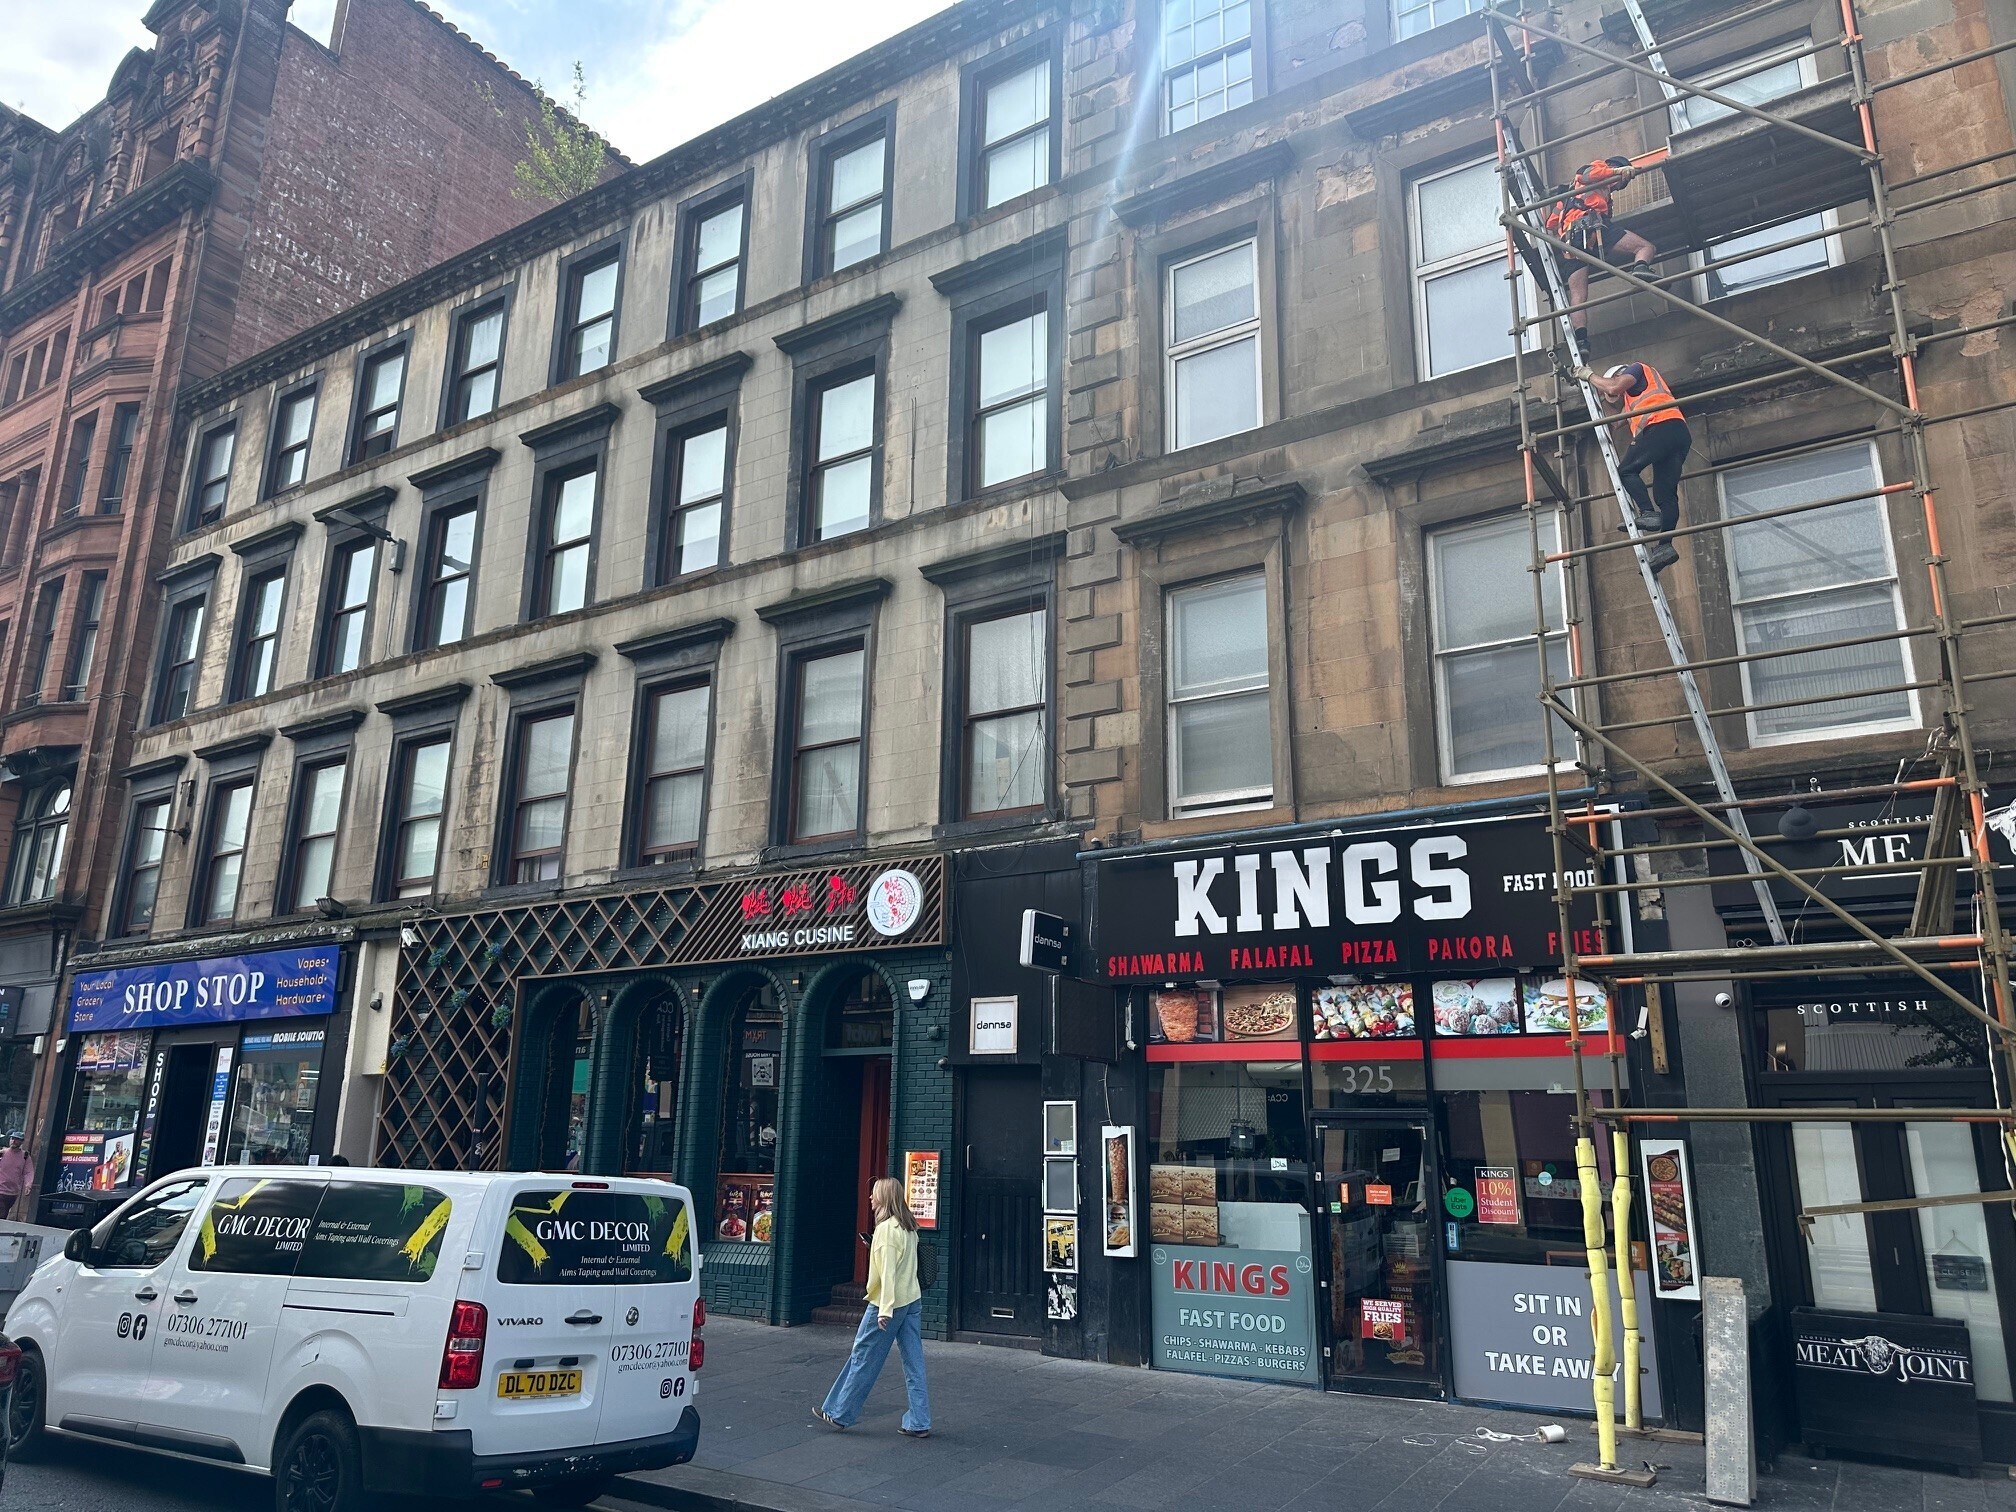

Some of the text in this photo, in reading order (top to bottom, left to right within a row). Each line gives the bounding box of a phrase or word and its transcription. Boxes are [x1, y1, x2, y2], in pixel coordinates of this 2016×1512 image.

[1848, 814, 1934, 829] SCOTTISH
[1172, 834, 1472, 937] KINGS
[1502, 872, 1547, 892] FAST
[741, 925, 854, 950] XIANG CUSINE
[1034, 934, 1062, 949] dannsa
[297, 957, 326, 970] Vapes
[1107, 951, 1204, 978] SHAWARMA
[1230, 944, 1313, 970] FALAFAL
[1342, 939, 1397, 964] PIZZA
[1427, 934, 1513, 961] PAKORA
[80, 979, 114, 991] Your Local
[276, 976, 323, 988] Household
[123, 971, 265, 1014] SHOP STOP
[275, 994, 322, 1006] Hardware
[77, 996, 104, 1007] Grocery
[1797, 1000, 1928, 1014] SCOTTISH
[74, 1011, 94, 1022] Store
[976, 1020, 1012, 1030] dannsa
[272, 1032, 297, 1043] MOBILE
[297, 1030, 325, 1042] SOLUTIO
[148, 1053, 164, 1112] SHOP
[1341, 1065, 1394, 1094] 325
[1480, 1170, 1509, 1178] KINGS
[1481, 1181, 1512, 1196] 10%
[1481, 1198, 1513, 1207] Student
[1481, 1206, 1515, 1215] Discount
[217, 1214, 311, 1239] GMC DECOR
[318, 1219, 341, 1229] Internal
[346, 1221, 371, 1231] External
[536, 1220, 650, 1242] GMC DECOR
[345, 1234, 358, 1243] and
[275, 1241, 303, 1252] LIMITED
[622, 1244, 651, 1253] LIMITED
[580, 1255, 641, 1264] Internal & External
[559, 1267, 657, 1278] Aims Taping and Wall Coverings
[1172, 1258, 1291, 1297] KINGS
[1374, 1300, 1402, 1308] SERVED
[1513, 1293, 1582, 1316] SIT IN
[497, 1317, 543, 1326] VIVARO
[1178, 1307, 1286, 1333] FAST FOOD
[1363, 1310, 1402, 1324] FRIES
[167, 1313, 248, 1340] 07306 277101
[1532, 1325, 1568, 1347] OR
[611, 1340, 690, 1362] 07306 277101
[1163, 1335, 1191, 1347] CHIPS
[1198, 1338, 1257, 1352] SHAWARMA
[1265, 1343, 1306, 1357] KEBABS
[618, 1358, 688, 1374] gmcdecor@yahoo.com
[1166, 1349, 1207, 1363] FALAFEL
[1214, 1354, 1250, 1367] PIZZAS
[1257, 1358, 1306, 1371] BURGERS
[1484, 1351, 1622, 1382] TAKE AWY
[1796, 1342, 1969, 1383] MEAT JOINT
[548, 1372, 576, 1391] DZC
